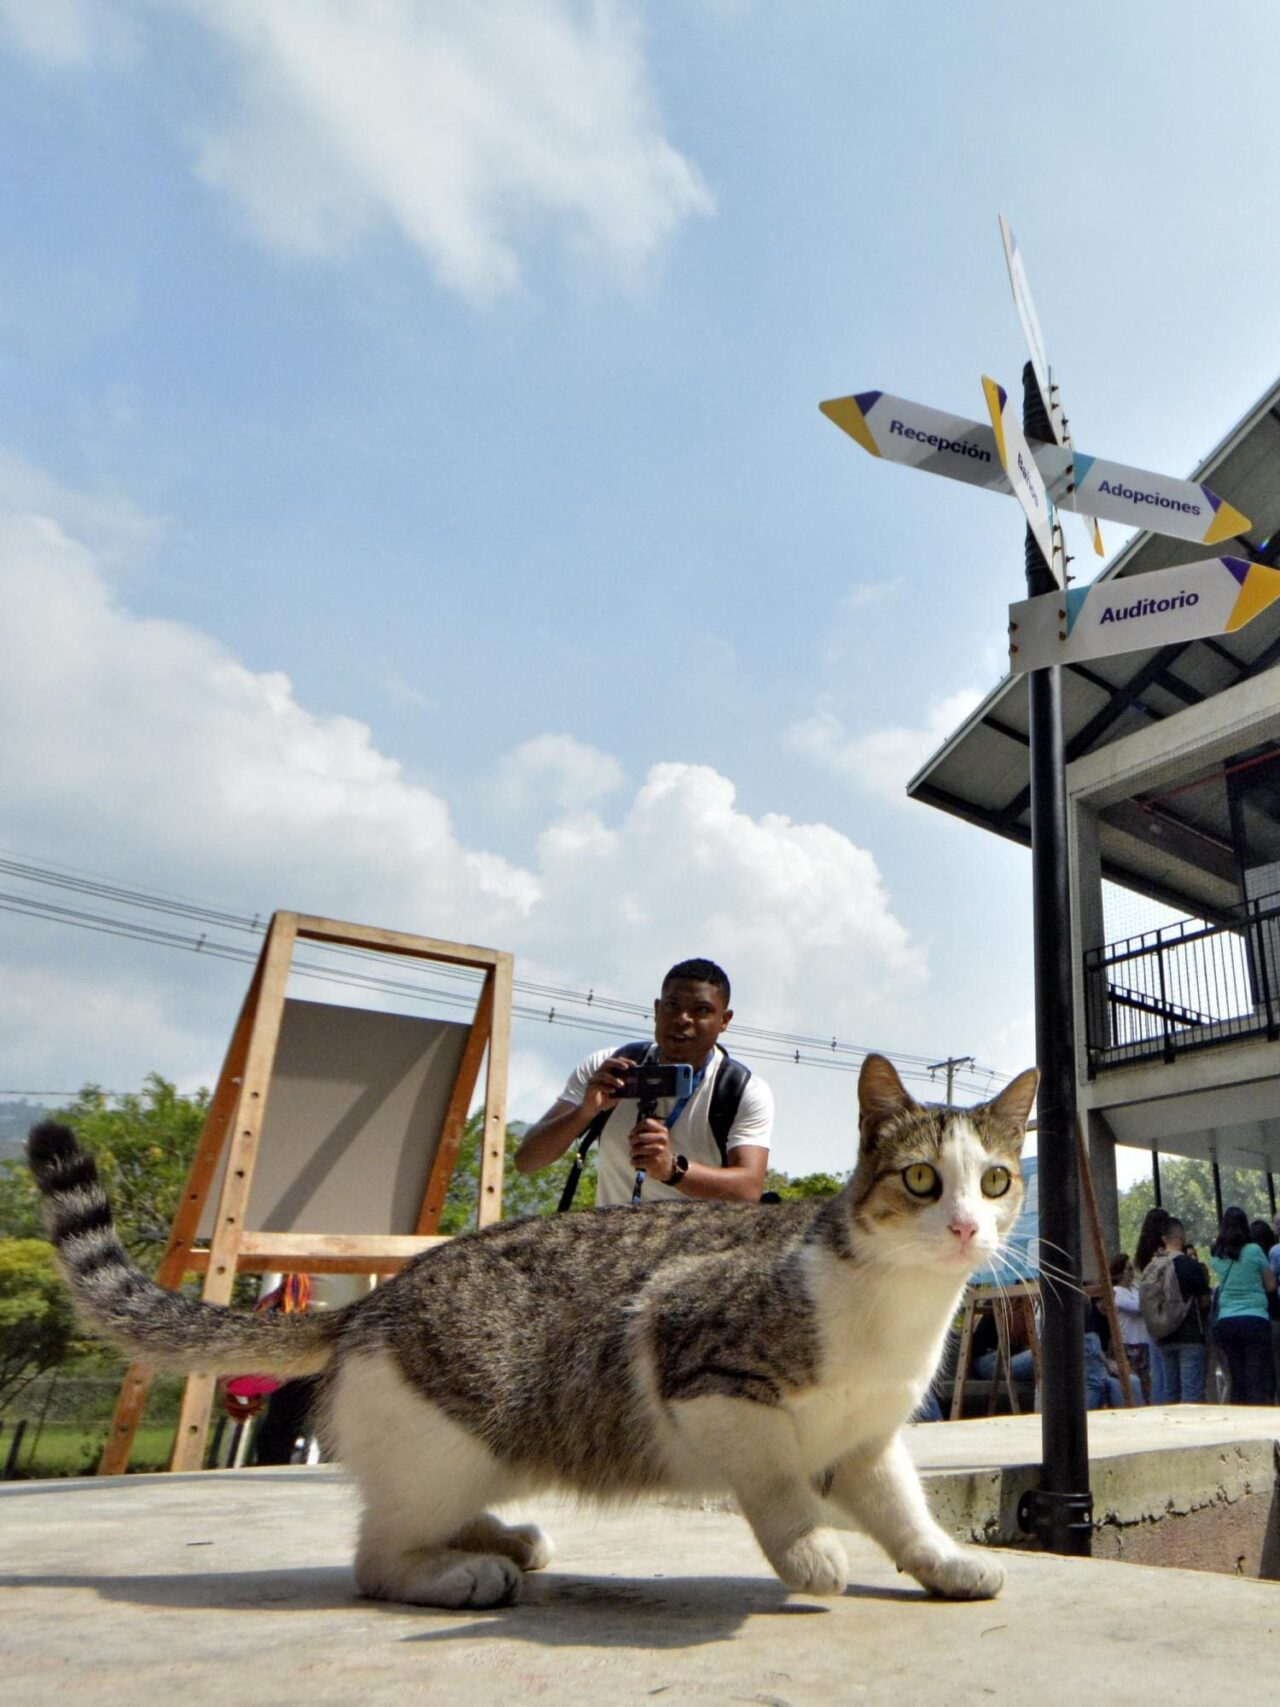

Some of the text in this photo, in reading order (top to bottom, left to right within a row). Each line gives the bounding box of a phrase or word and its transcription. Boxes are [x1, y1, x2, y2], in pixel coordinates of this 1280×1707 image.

[889, 420, 991, 463] Recepción
[1098, 480, 1201, 516] Adopciones
[1099, 590, 1199, 625] Auditorio
